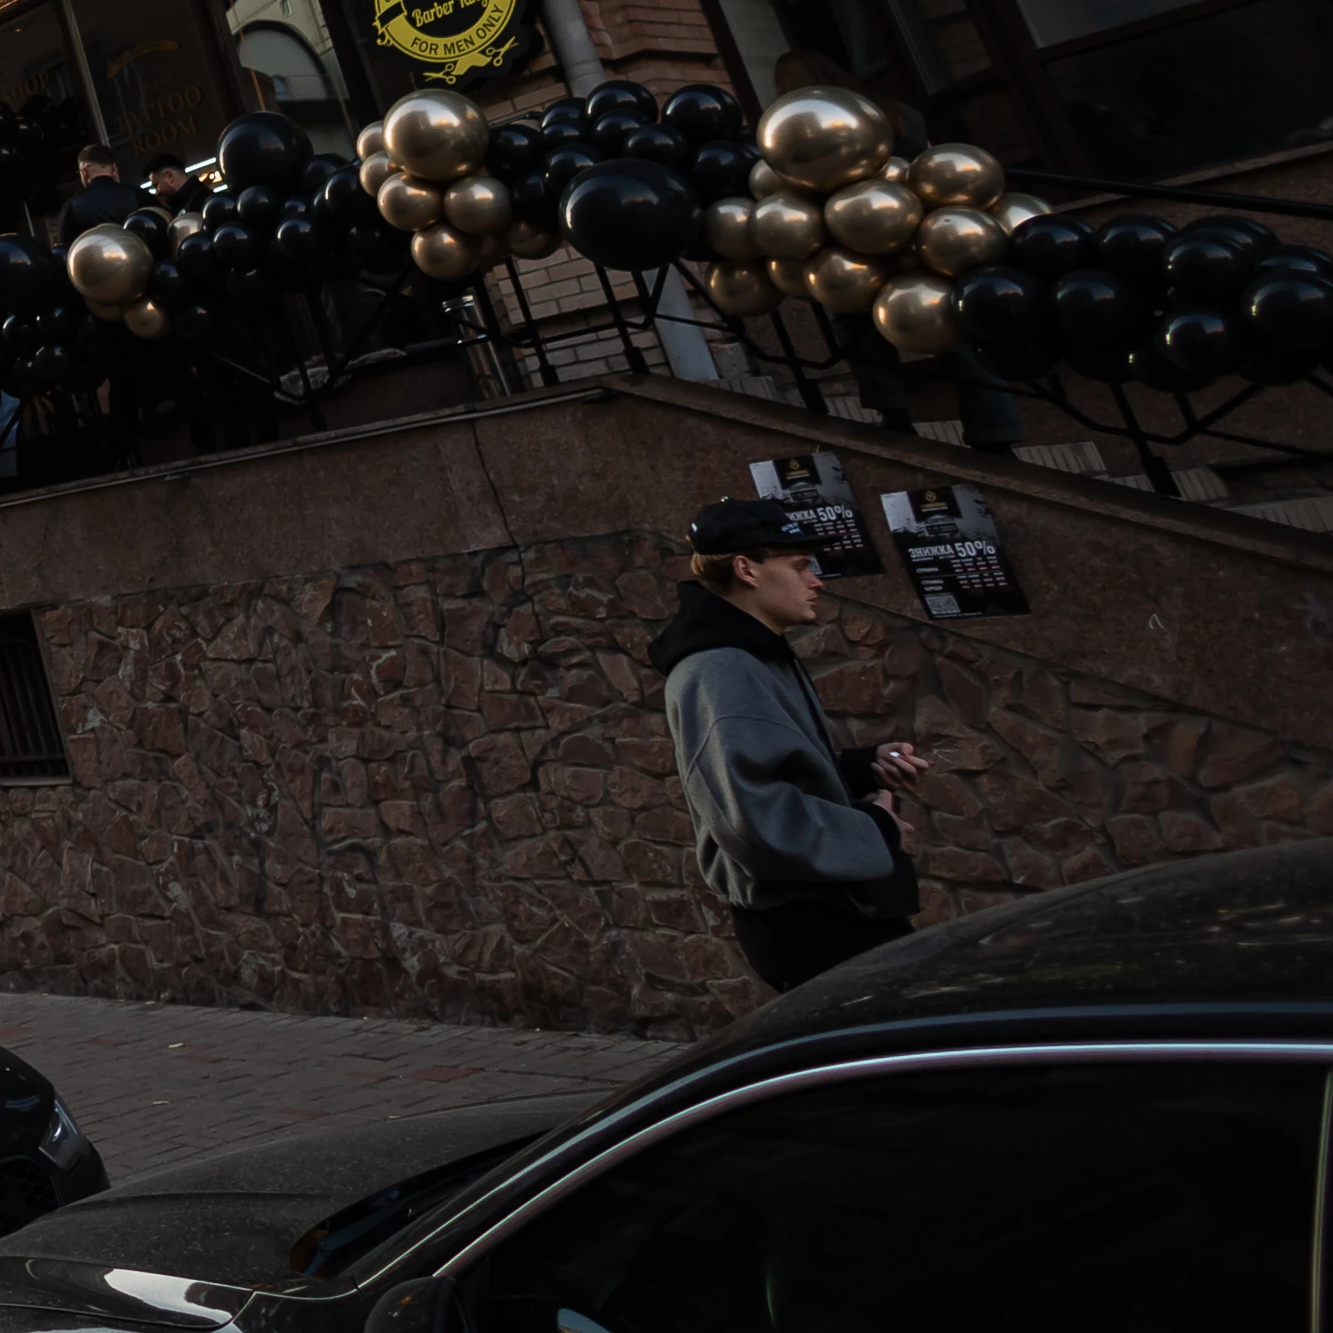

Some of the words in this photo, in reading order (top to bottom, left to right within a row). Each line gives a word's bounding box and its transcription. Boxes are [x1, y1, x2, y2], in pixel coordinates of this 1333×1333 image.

[411, 0, 455, 27] Barber
[410, 37, 439, 55] FOR
[443, 35, 476, 56] MEN
[475, 3, 504, 40] ONLY
[816, 505, 854, 522] 50%
[908, 543, 955, 559] ЗНИЖКА
[954, 540, 996, 557] 50%
